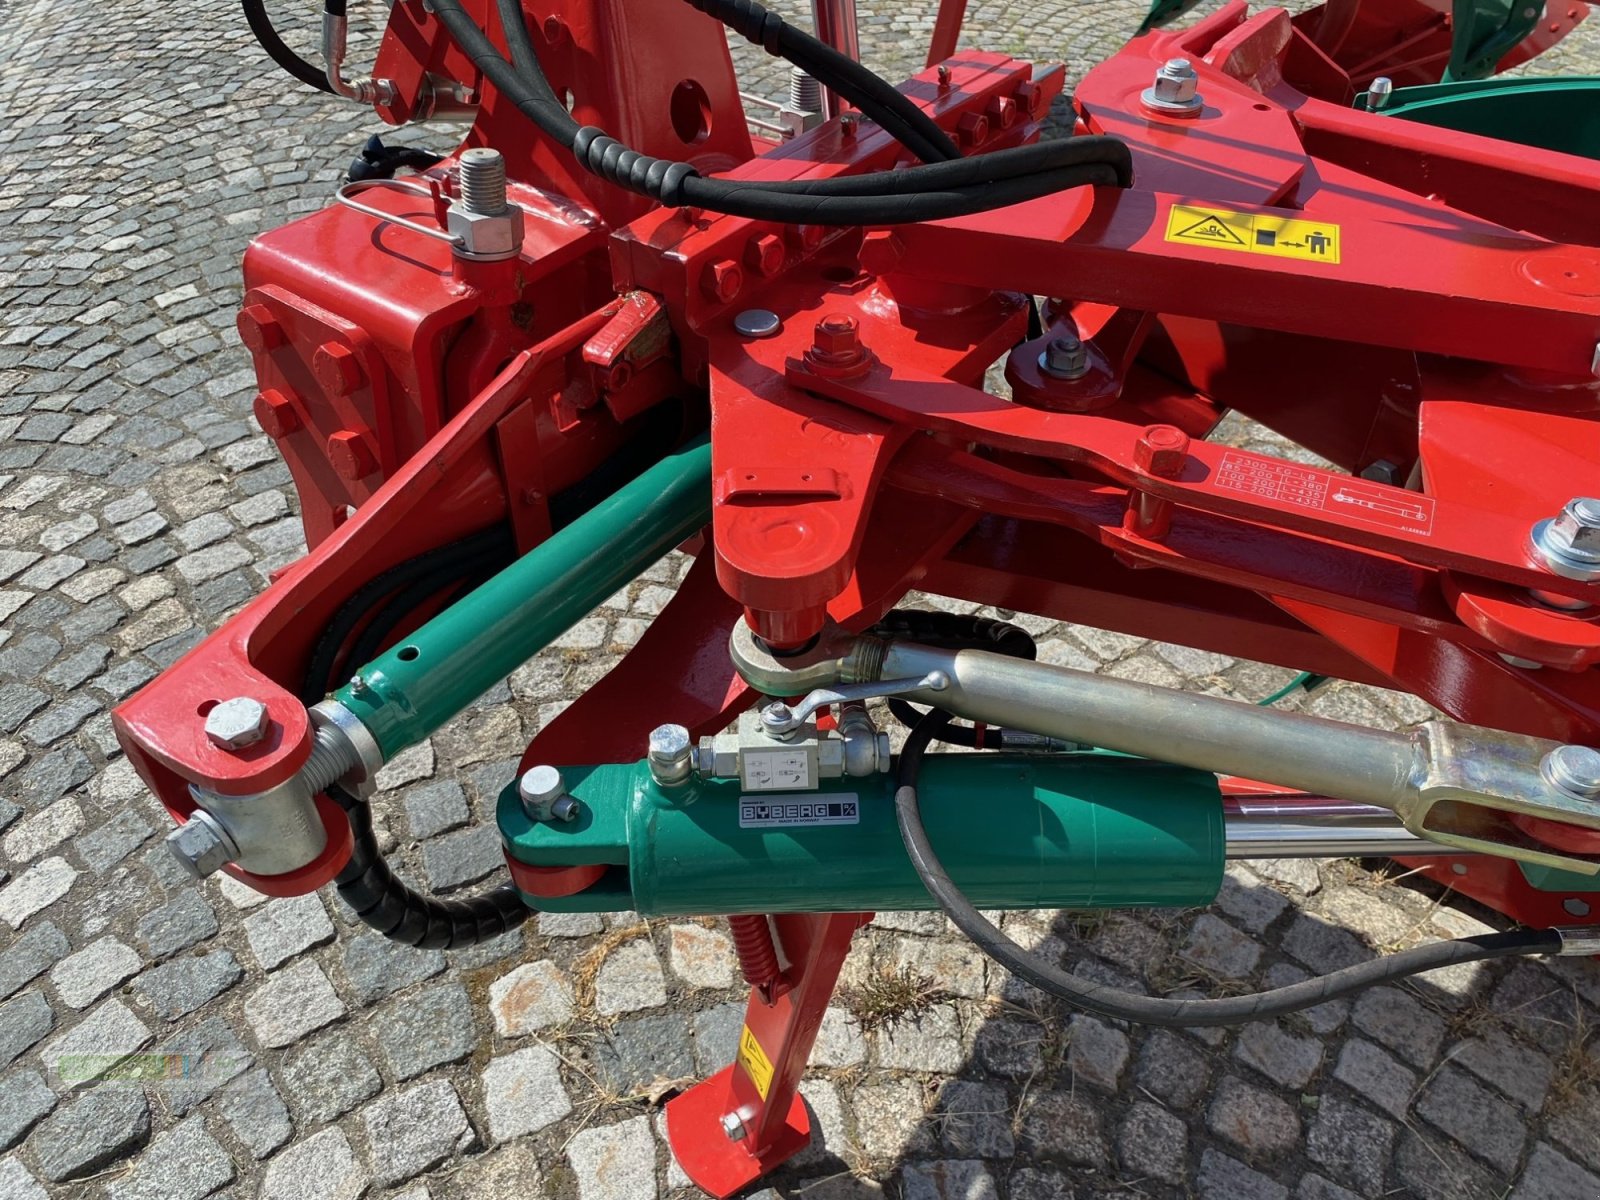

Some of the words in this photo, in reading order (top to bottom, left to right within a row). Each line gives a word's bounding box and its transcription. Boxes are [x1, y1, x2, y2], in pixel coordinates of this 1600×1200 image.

[1235, 457, 1316, 481] 2300-EG-LB
[1220, 479, 1274, 497] 115-200
[1223, 471, 1276, 489] 100-200
[1279, 492, 1319, 507] L=435
[1282, 484, 1321, 499] L=435
[742, 804, 827, 819] BYBERG
